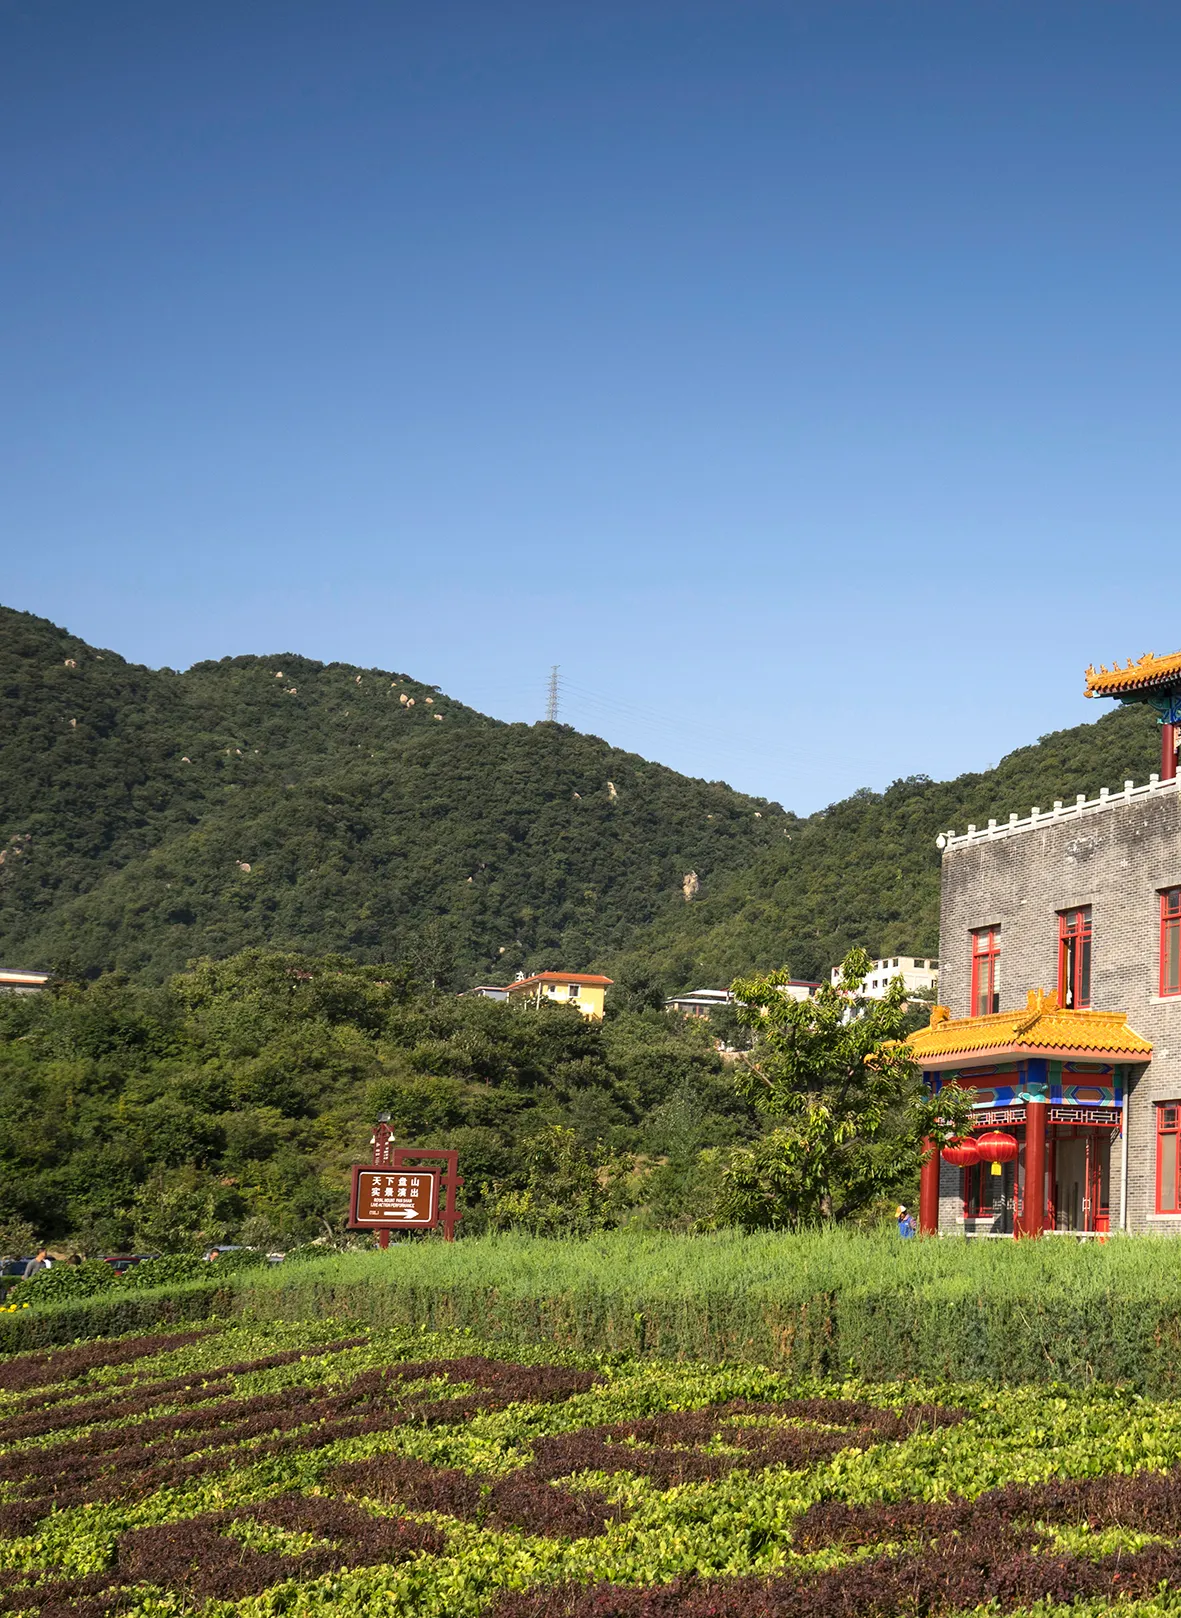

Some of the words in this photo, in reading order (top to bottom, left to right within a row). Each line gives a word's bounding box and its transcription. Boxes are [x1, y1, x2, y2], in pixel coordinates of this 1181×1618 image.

[372, 1176, 420, 1187] 天下盘山
[371, 1187, 419, 1198] 实景演出
